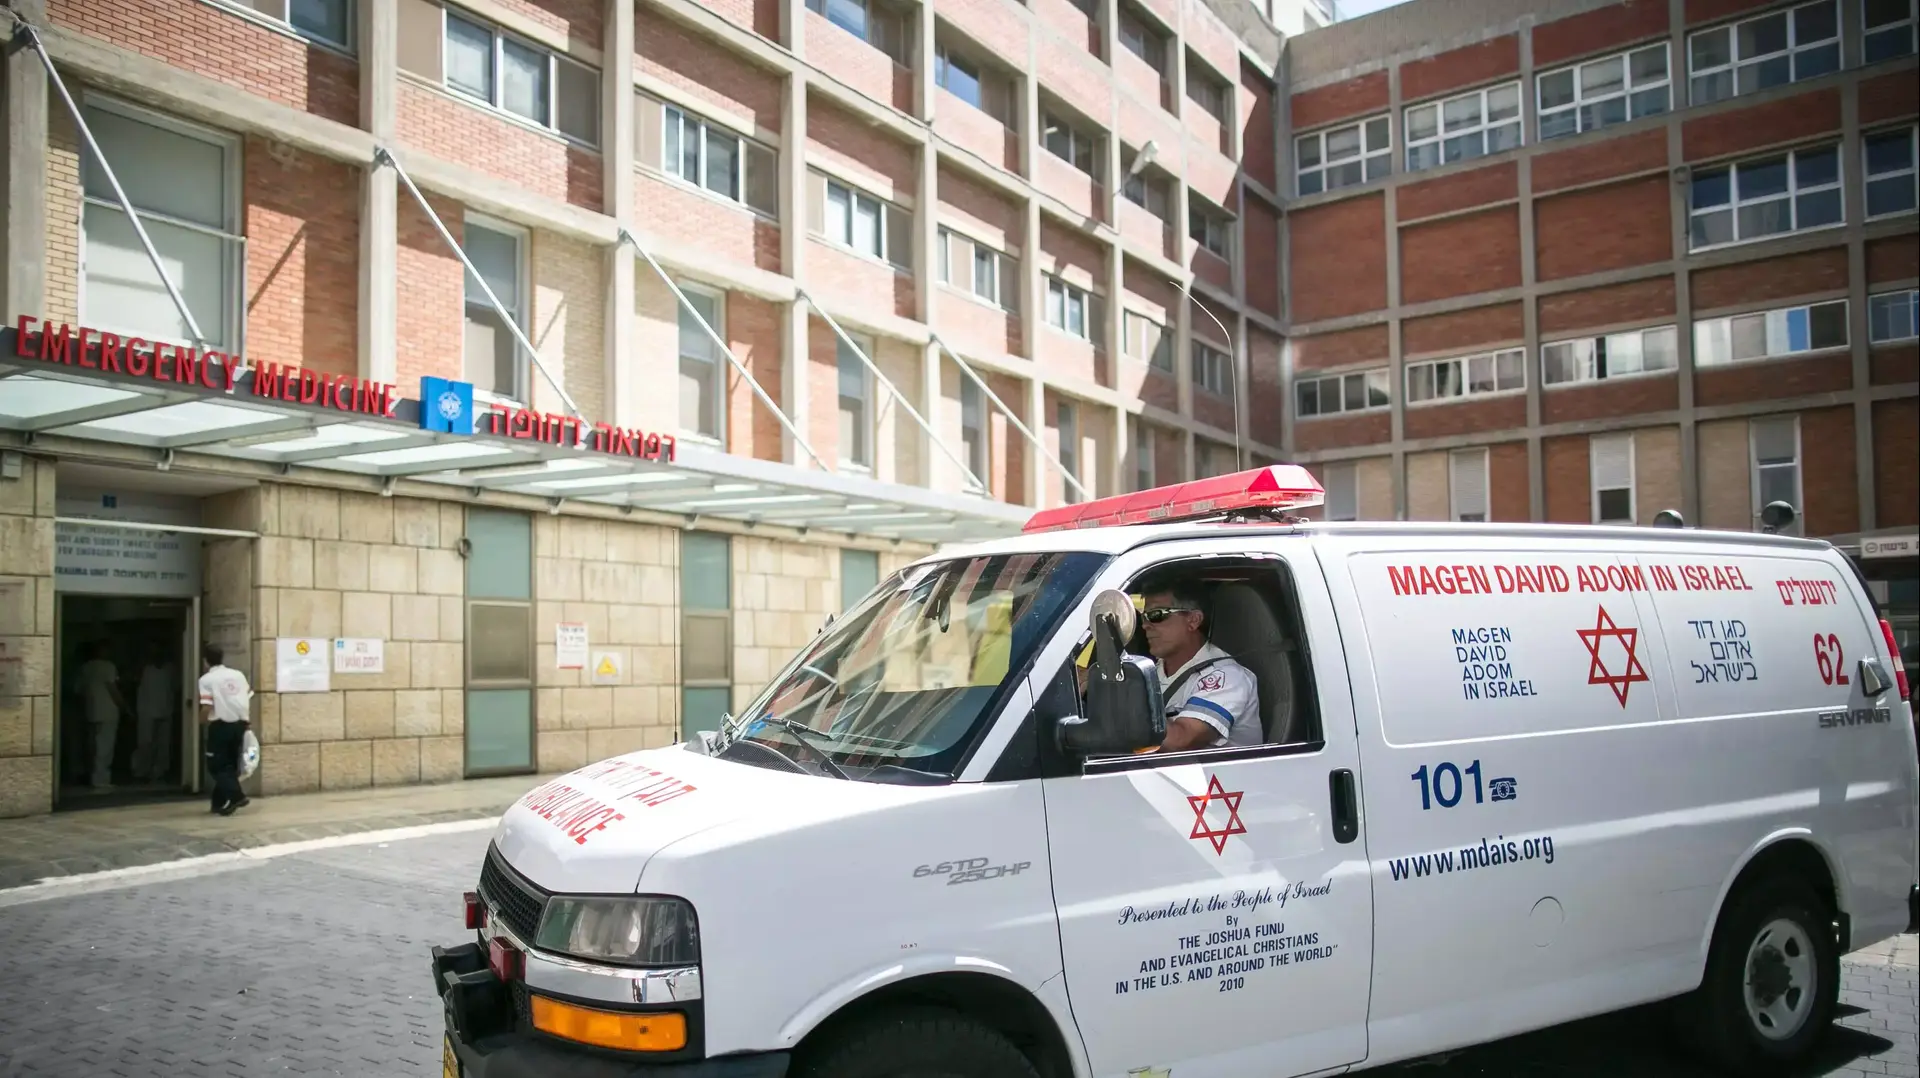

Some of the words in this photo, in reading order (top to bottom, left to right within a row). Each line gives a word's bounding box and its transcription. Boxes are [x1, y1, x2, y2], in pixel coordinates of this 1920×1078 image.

[17, 315, 239, 393] EMERGENCY
[253, 360, 397, 418] MEDICINE
[490, 403, 583, 448] דחופה
[595, 421, 675, 463] רפואה
[1387, 565, 1493, 595] MAGEN
[1494, 565, 1570, 593] DAVID
[1577, 565, 1648, 592] ADOM
[1650, 565, 1678, 591] IN
[1678, 565, 1753, 591] ISRAEL
[1776, 576, 1837, 605] ירושלים
[1452, 627, 1511, 644] MAGEN
[1687, 620, 1715, 639] דוד
[1720, 620, 1746, 640] מגן
[1456, 645, 1507, 663] DAVID
[1710, 640, 1753, 660] אדום
[1814, 633, 1849, 685] 62
[1462, 663, 1513, 681] ADOM
[1690, 660, 1758, 683] בישראל
[1463, 683, 1480, 700] IN
[1484, 680, 1538, 699] ISRAEL
[1818, 706, 1891, 728] SAVANA
[1411, 759, 1484, 810] 101
[912, 857, 989, 878] 6.6TD
[1389, 835, 1554, 881] www.mdais.org
[946, 861, 1031, 886] 250HP
[1118, 899, 1188, 926] Presented
[1191, 897, 1204, 913] to
[1207, 894, 1228, 912] the
[1231, 887, 1273, 912] People
[1276, 883, 1292, 908] of
[1292, 878, 1332, 900] Israel
[1226, 915, 1239, 927] By
[1178, 935, 1201, 950] THE
[1205, 928, 1251, 946] JOSHUA
[1255, 922, 1285, 937] FUND
[1139, 958, 1166, 974] AND
[1170, 944, 1249, 968] EVANGELICAL
[1253, 932, 1319, 954] CHRISTIANS
[1115, 980, 1129, 994] IN
[1133, 976, 1157, 991] THE
[1160, 972, 1183, 986] U.S.
[1187, 967, 1213, 982] AND
[1217, 958, 1265, 976] AROUND
[1269, 952, 1290, 967] THE
[1219, 976, 1245, 992] 2010
